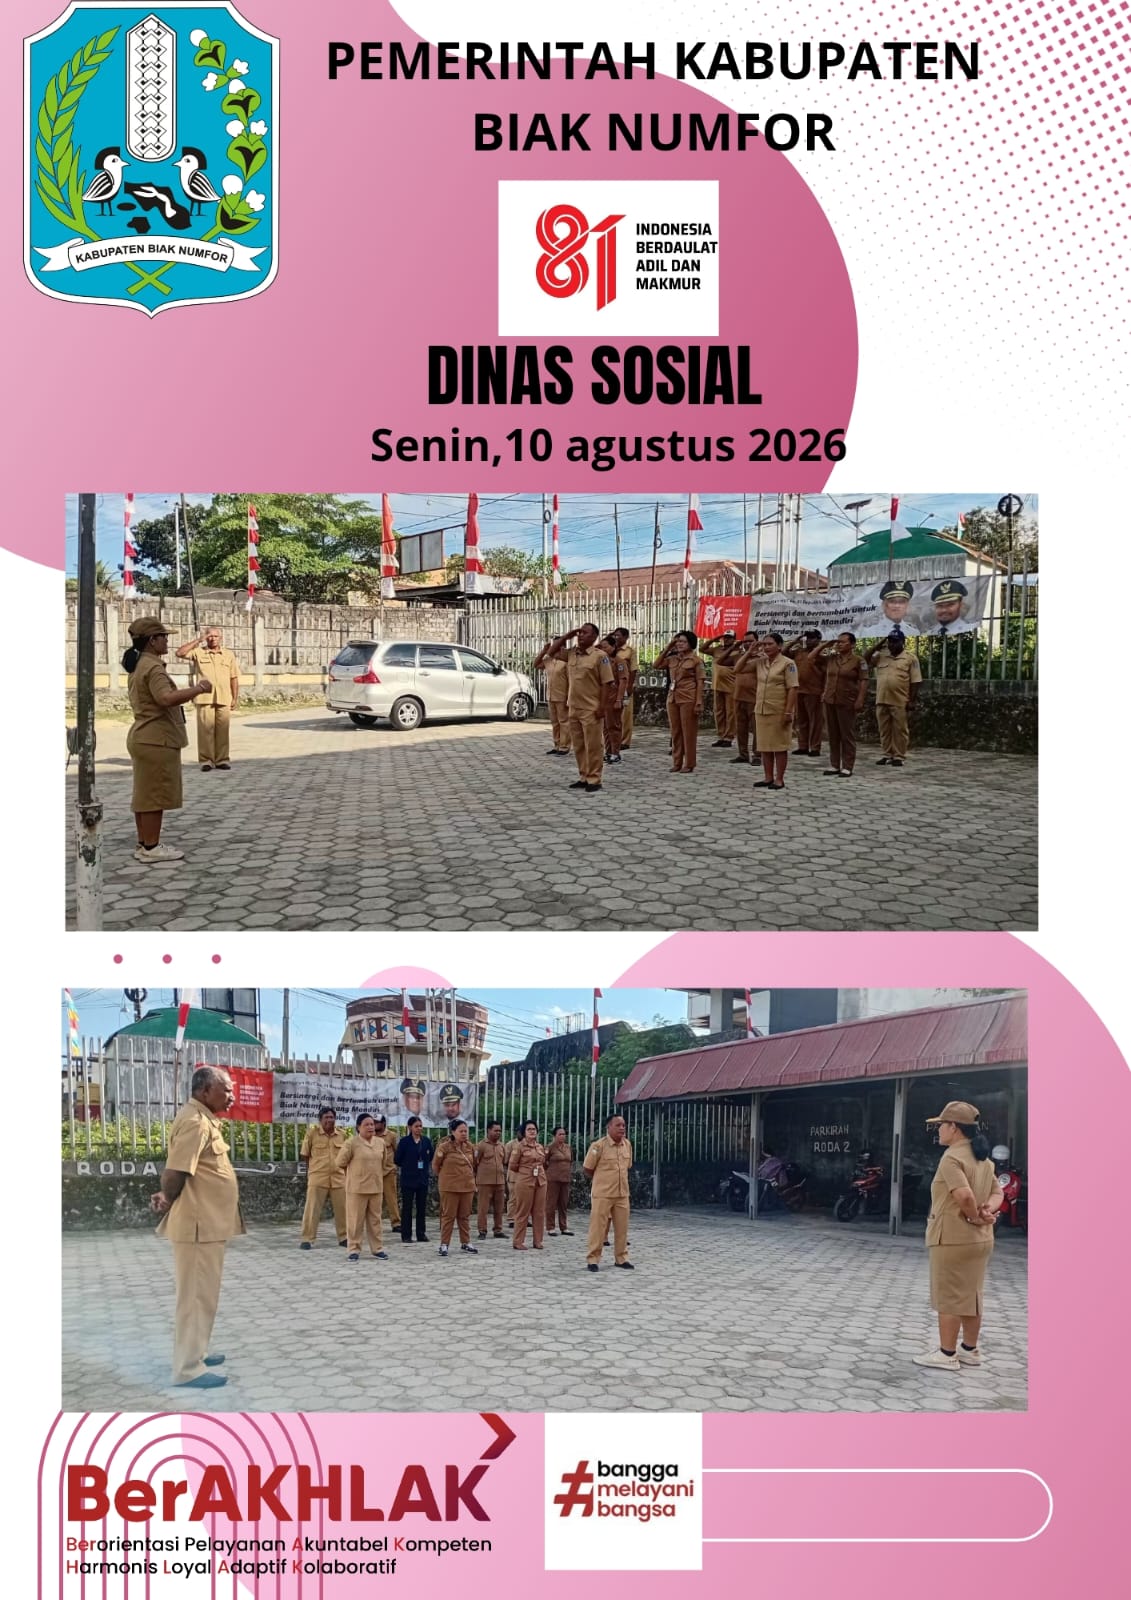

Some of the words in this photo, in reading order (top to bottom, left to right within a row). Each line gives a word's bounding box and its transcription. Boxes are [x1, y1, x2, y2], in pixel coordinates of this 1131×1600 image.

[813, 1141, 841, 1153] RODA
[843, 1141, 851, 1153] 2
[77, 1161, 158, 1176] RODA
